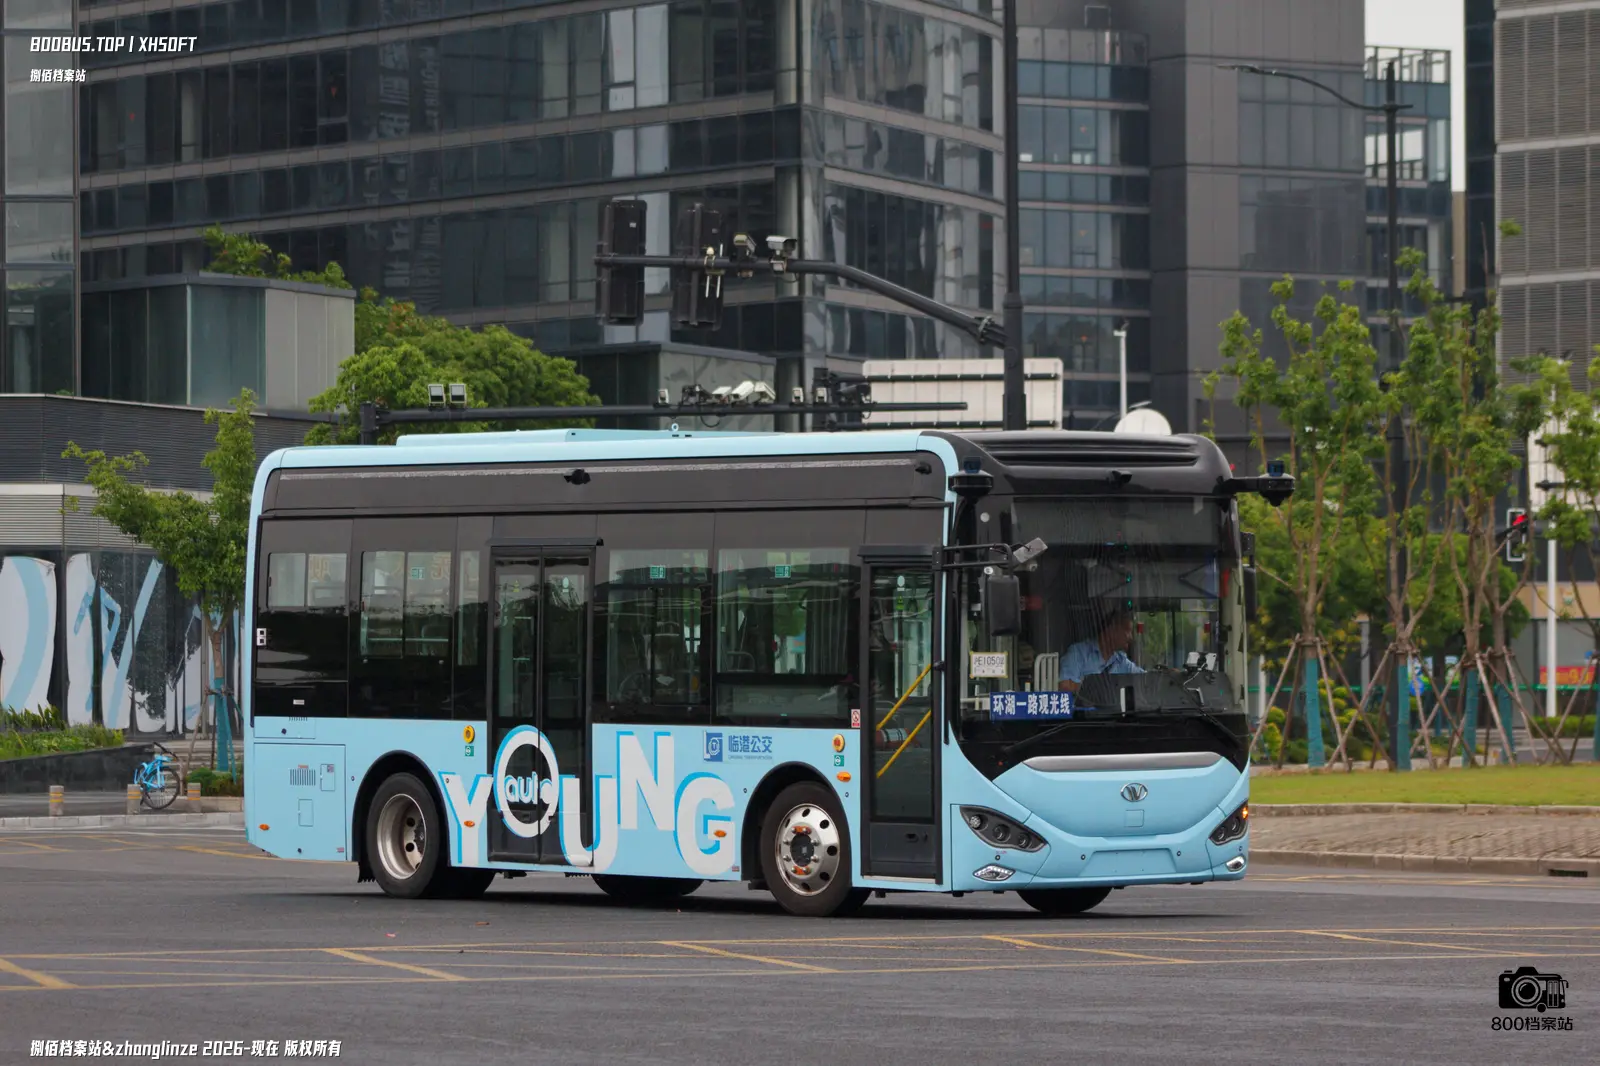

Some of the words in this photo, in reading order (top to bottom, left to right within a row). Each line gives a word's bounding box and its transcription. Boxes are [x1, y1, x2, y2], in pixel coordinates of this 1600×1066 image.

[993, 693, 1071, 715] 环湖一路观光线
[728, 735, 773, 753] 临港公交
[438, 724, 736, 876] YOUNG
